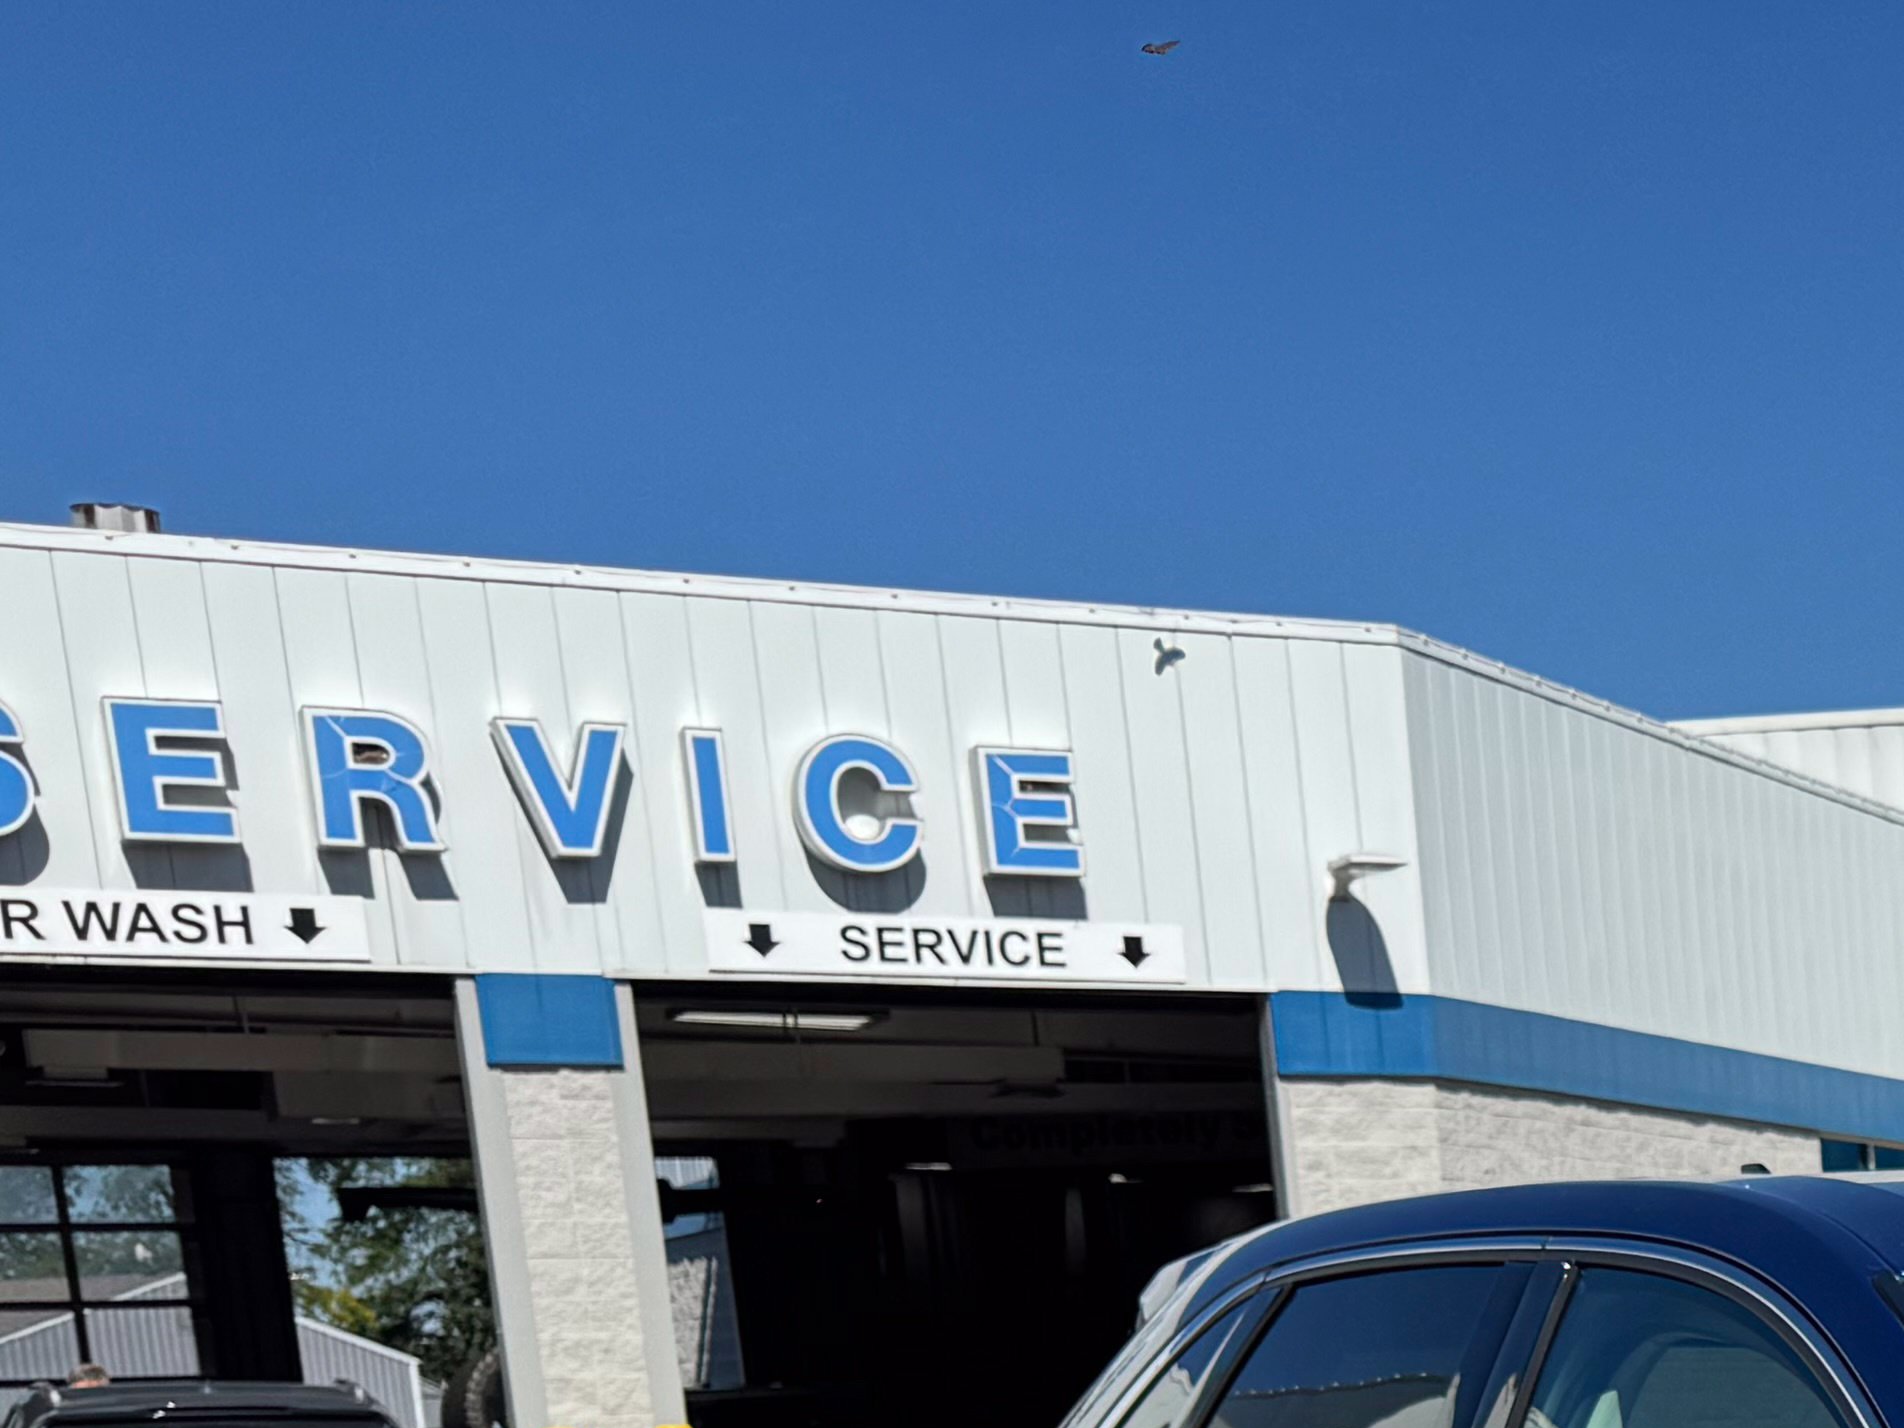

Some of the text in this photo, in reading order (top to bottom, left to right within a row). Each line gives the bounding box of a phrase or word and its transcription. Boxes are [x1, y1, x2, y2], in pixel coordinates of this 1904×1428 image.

[0, 695, 1086, 878] ERVICE
[61, 900, 255, 945] WASH
[840, 925, 1068, 967] SERVICE
